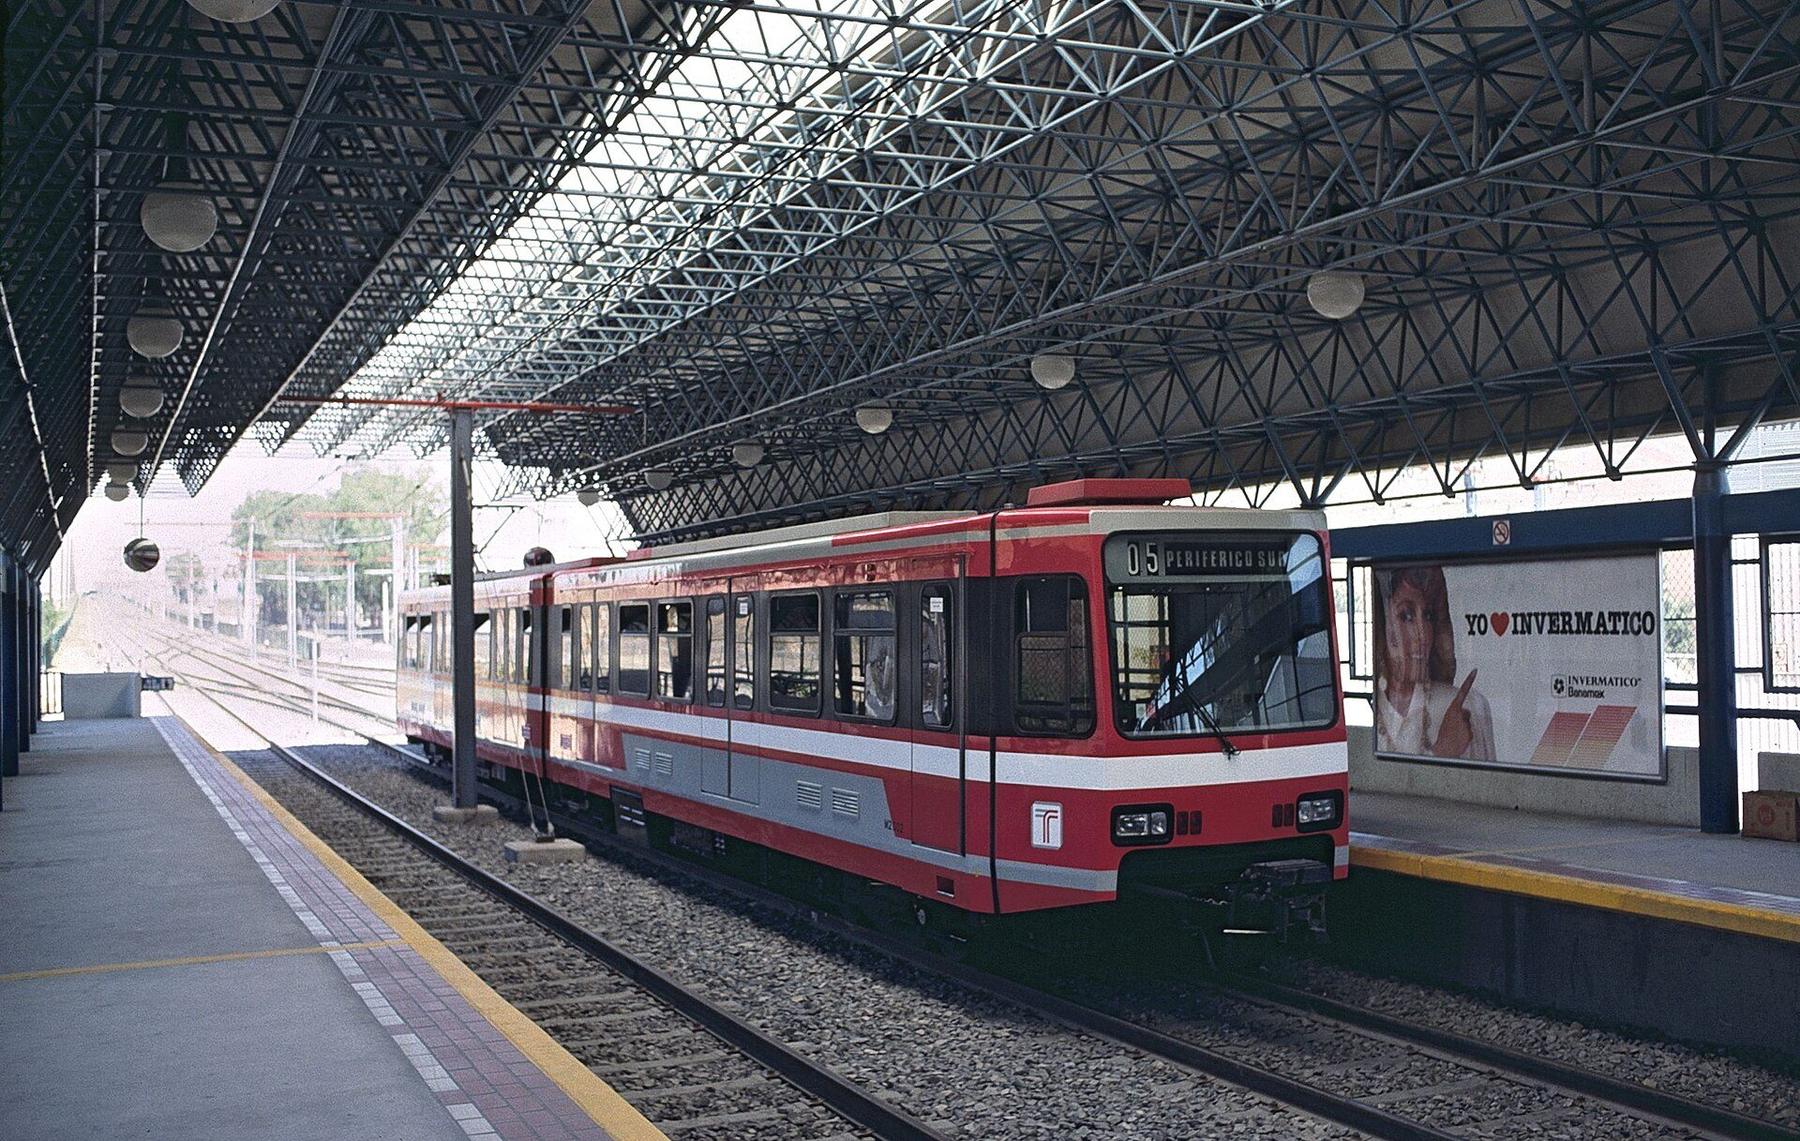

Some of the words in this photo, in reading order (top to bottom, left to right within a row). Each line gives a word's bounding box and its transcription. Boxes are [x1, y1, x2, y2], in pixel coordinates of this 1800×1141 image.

[1166, 550, 1253, 568] PERIFERICO
[1465, 613, 1489, 636] YO
[1511, 611, 1656, 636] INVERMATICO
[1568, 675, 1638, 688] INVERMATICO
[1568, 686, 1605, 698] Banamex
